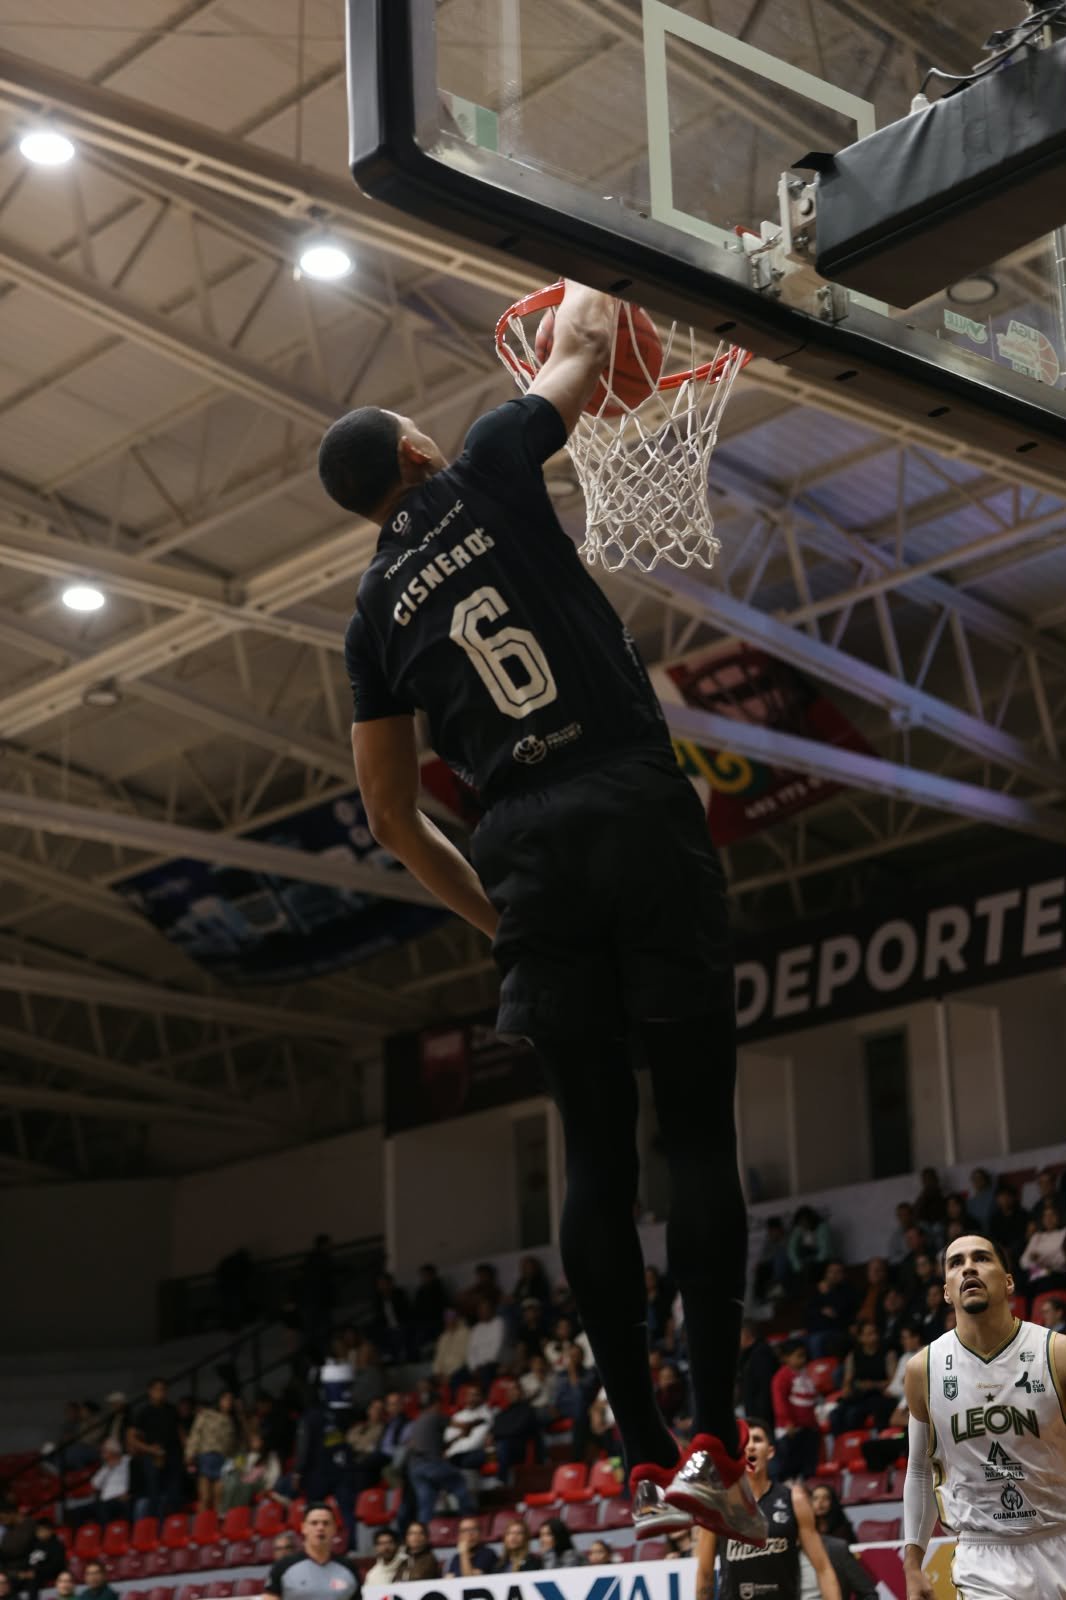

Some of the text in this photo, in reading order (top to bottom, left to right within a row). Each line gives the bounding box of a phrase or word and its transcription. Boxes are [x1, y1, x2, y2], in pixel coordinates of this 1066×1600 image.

[393, 527, 496, 627] CISNEROS
[449, 586, 557, 719] 6
[734, 877, 1066, 1029] DEPORTE
[945, 1354, 953, 1371] 9
[993, 1509, 1037, 1520] GUANAJUATO
